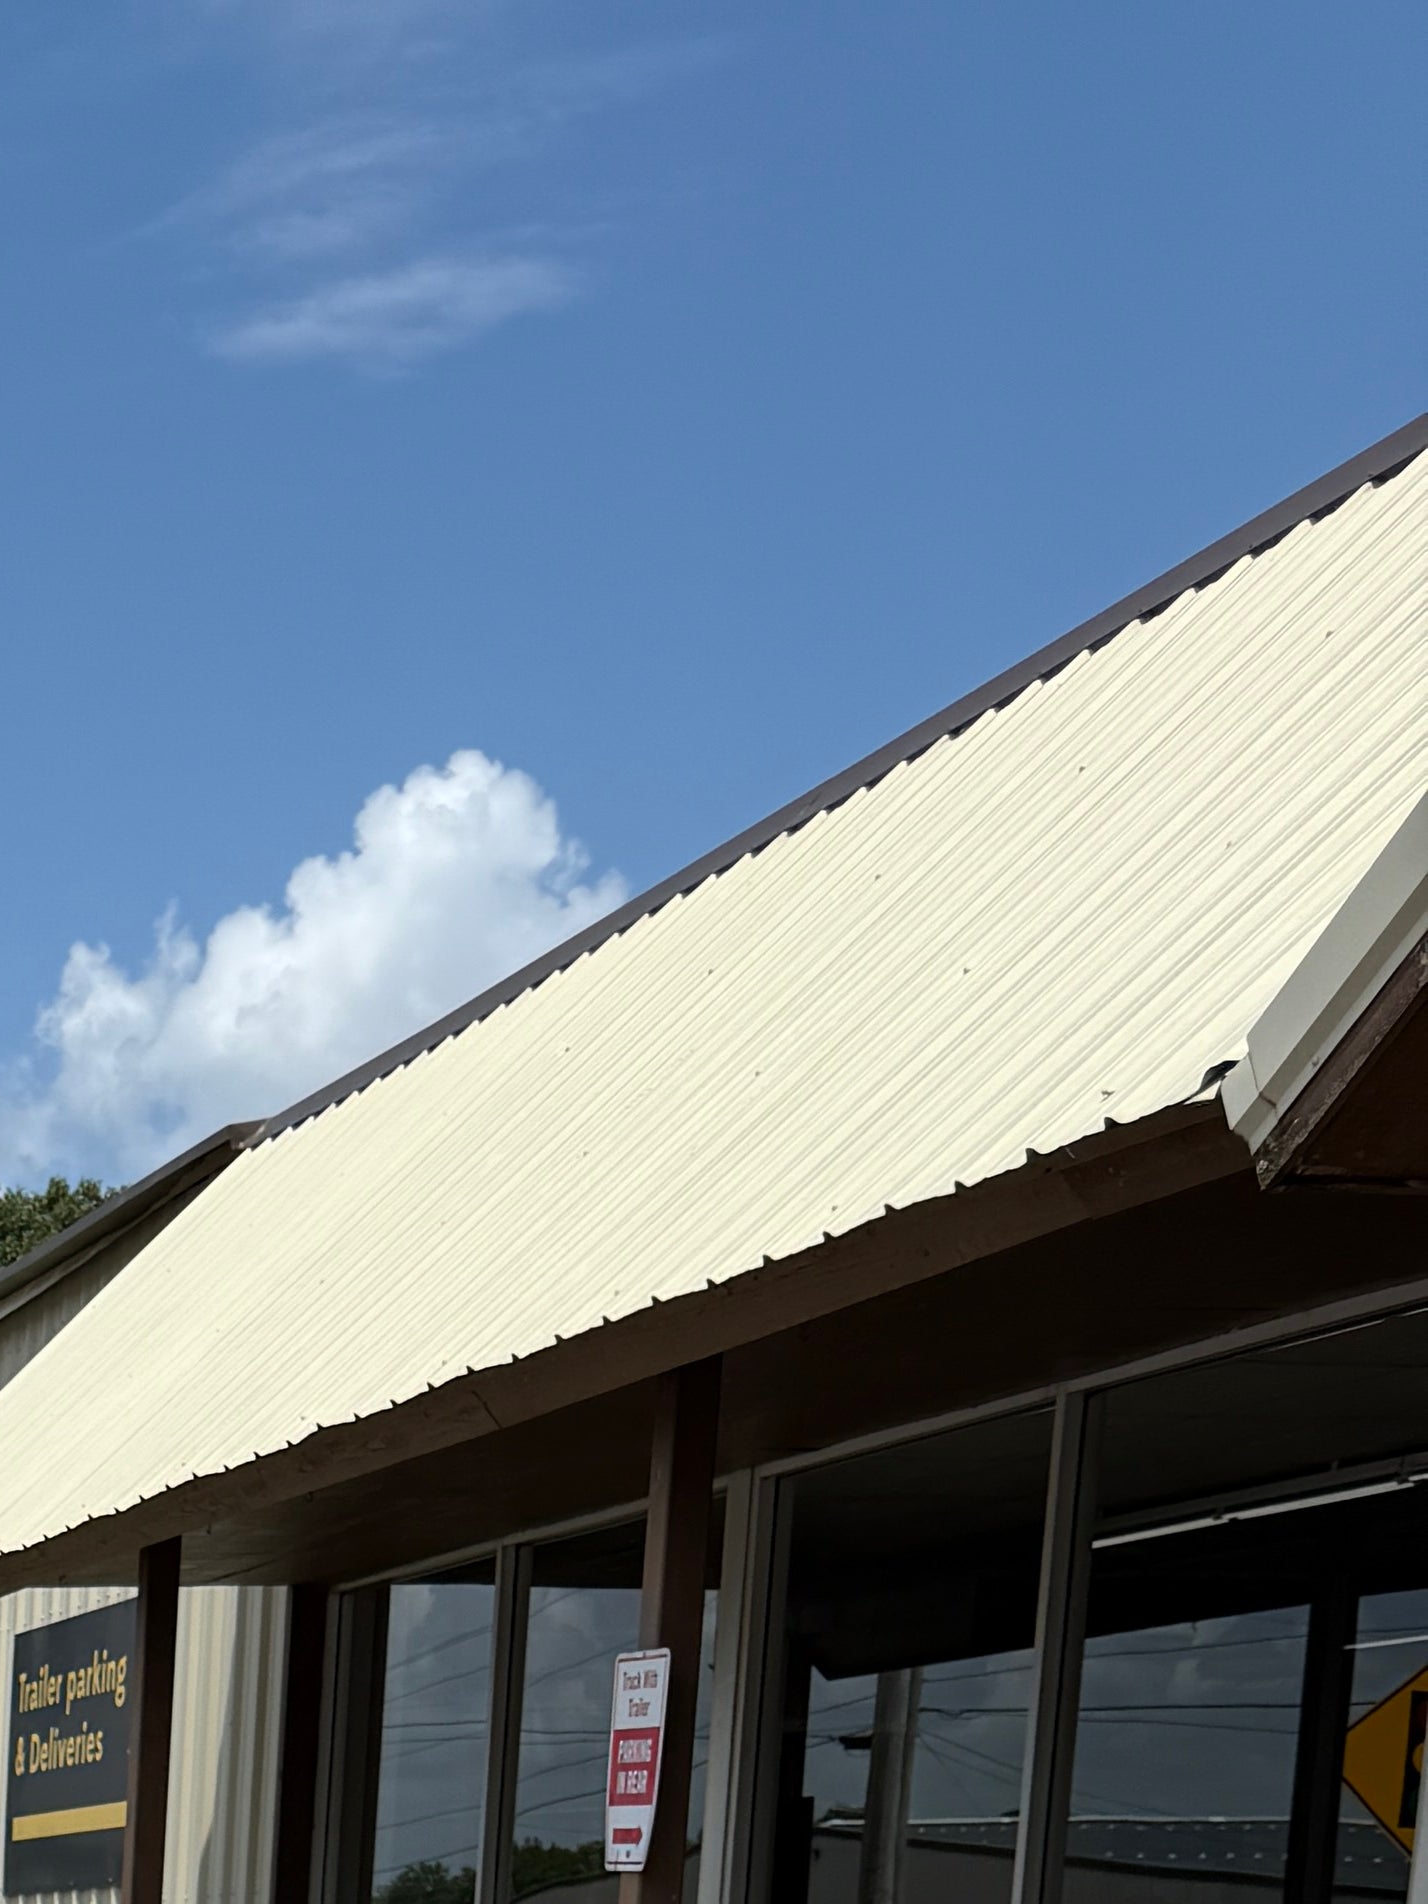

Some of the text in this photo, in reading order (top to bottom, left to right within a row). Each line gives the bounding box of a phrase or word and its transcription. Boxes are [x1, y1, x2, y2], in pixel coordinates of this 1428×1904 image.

[18, 1649, 127, 1716] Trailer parking
[628, 1698, 651, 1718] Trailer
[15, 1721, 104, 1776] & Deliveries
[617, 1739, 653, 1764] PARKING
[616, 1770, 648, 1795] IN REAR
